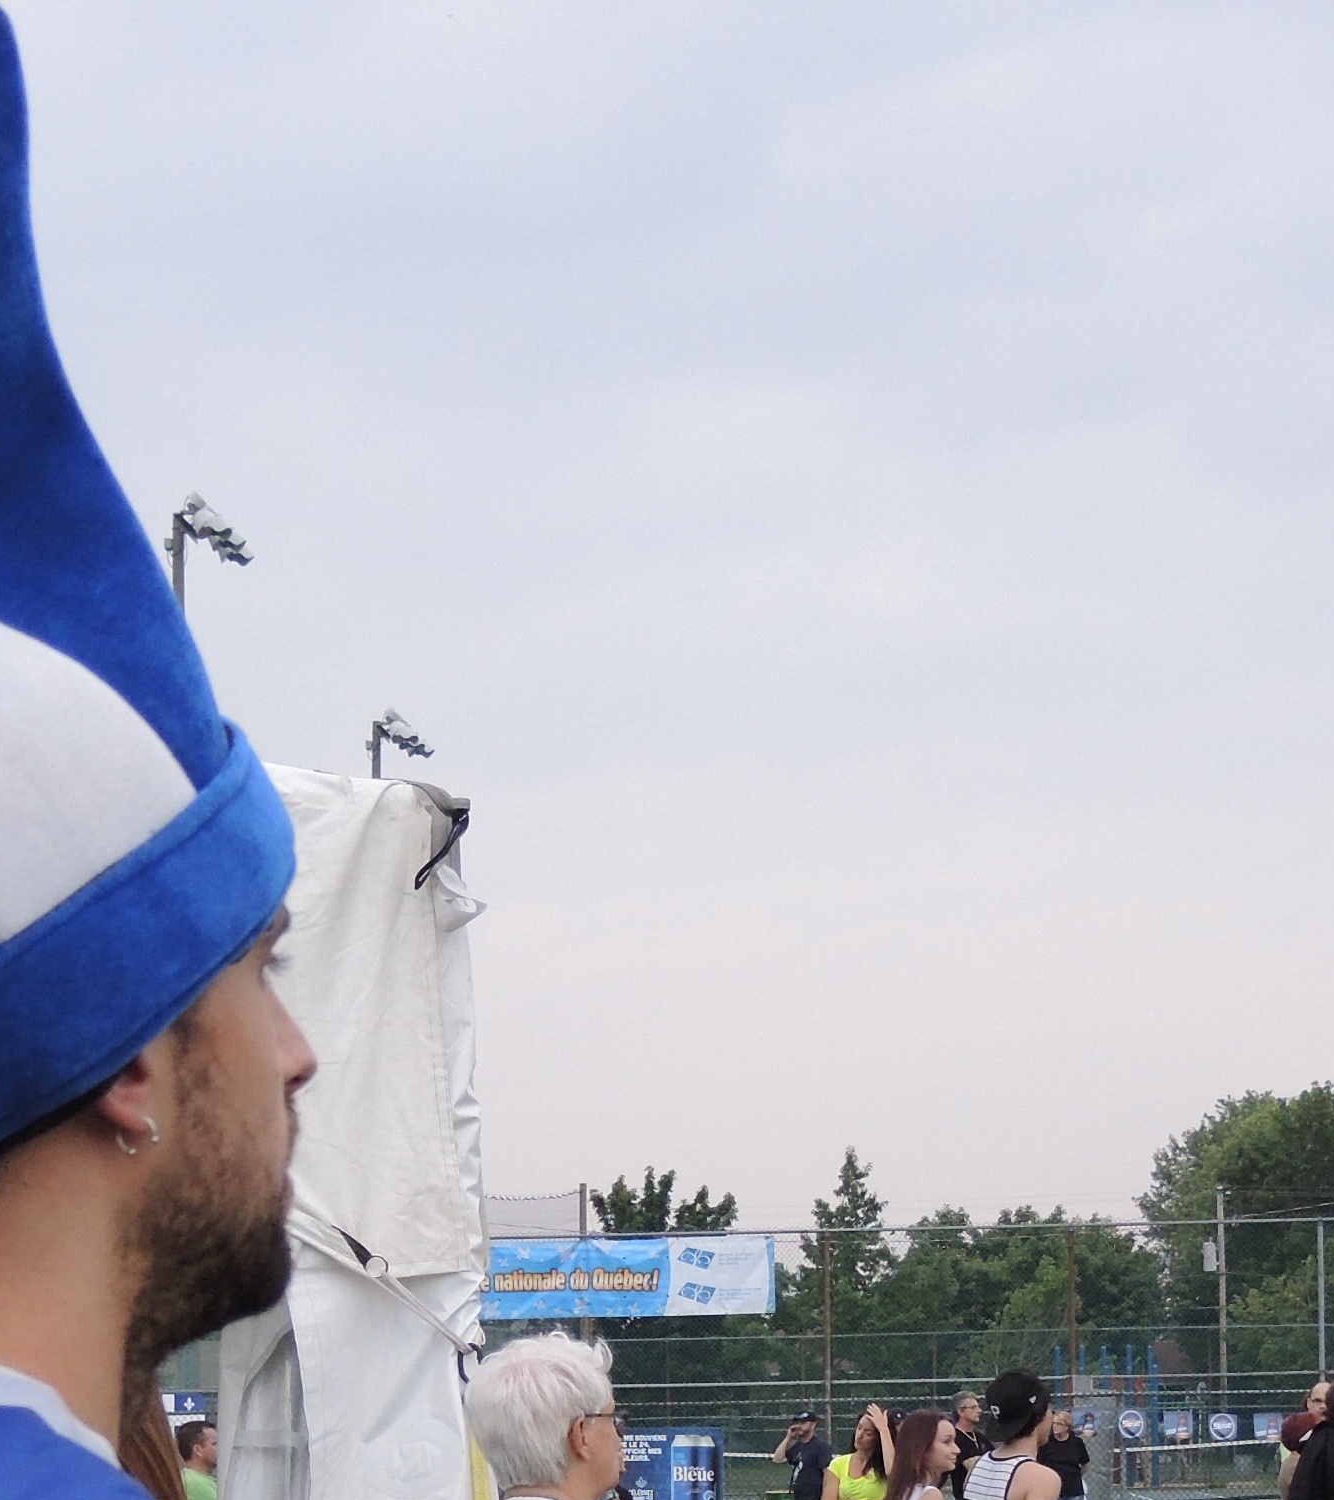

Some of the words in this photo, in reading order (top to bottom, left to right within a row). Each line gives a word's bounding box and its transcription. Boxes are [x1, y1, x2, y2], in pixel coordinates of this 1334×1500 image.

[494, 1269, 566, 1292] nationale
[570, 1268, 589, 1291] du
[990, 1405, 1001, 1420] P
[672, 1465, 715, 1482] Bleue
